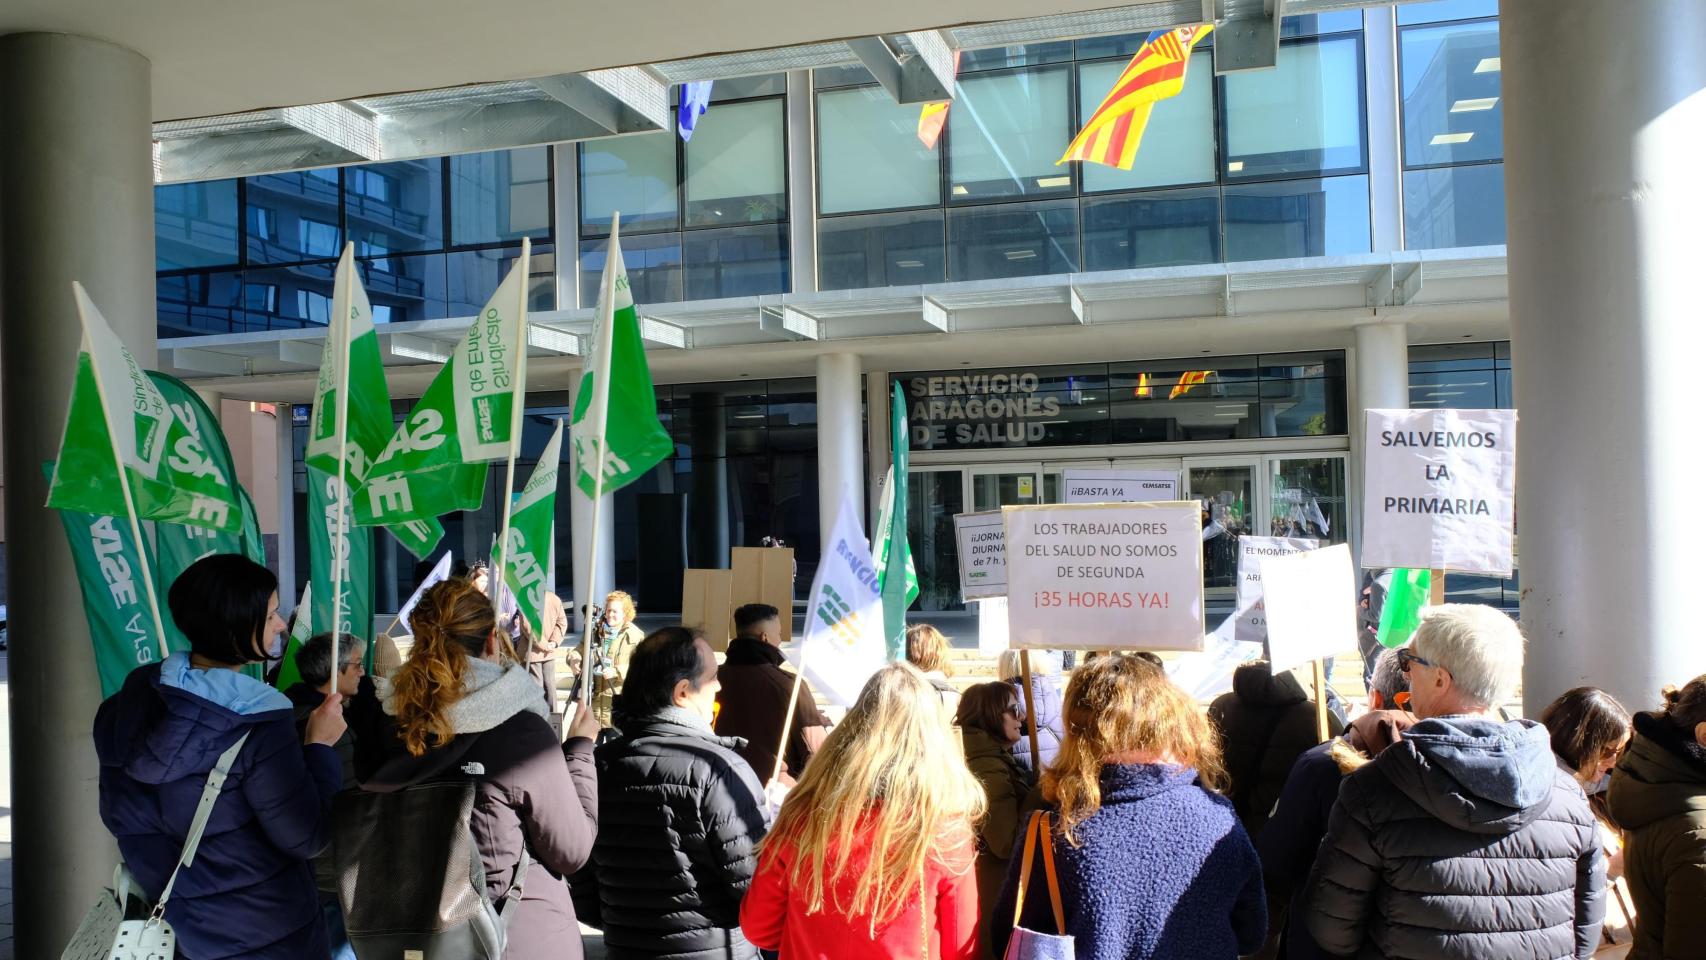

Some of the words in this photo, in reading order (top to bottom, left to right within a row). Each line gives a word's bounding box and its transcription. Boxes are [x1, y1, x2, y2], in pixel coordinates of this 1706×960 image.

[910, 372, 1039, 397] SERVICIO
[912, 424, 948, 445] DE
[955, 421, 1046, 444] SALUD
[1381, 430, 1496, 448] SALVEMOS
[1425, 464, 1450, 481] LA
[1111, 488, 1125, 496] YA
[1384, 496, 1490, 515] PRIMARIA
[1034, 523, 1058, 535] LOS
[1062, 523, 1167, 535] TRABAJADORES
[1025, 544, 1050, 557] DEL
[1053, 544, 1096, 557] SALUD
[1101, 544, 1122, 557] NO
[1125, 544, 1177, 557] SOMOS
[973, 558, 984, 566] de
[986, 556, 992, 566] 7
[1057, 566, 1074, 578] DE
[1078, 566, 1144, 578] SEGUNDA
[1034, 591, 1062, 608] ¡35
[1068, 591, 1132, 607] HORAS
[1138, 592, 1169, 608] YA!
[1251, 617, 1259, 625] O
